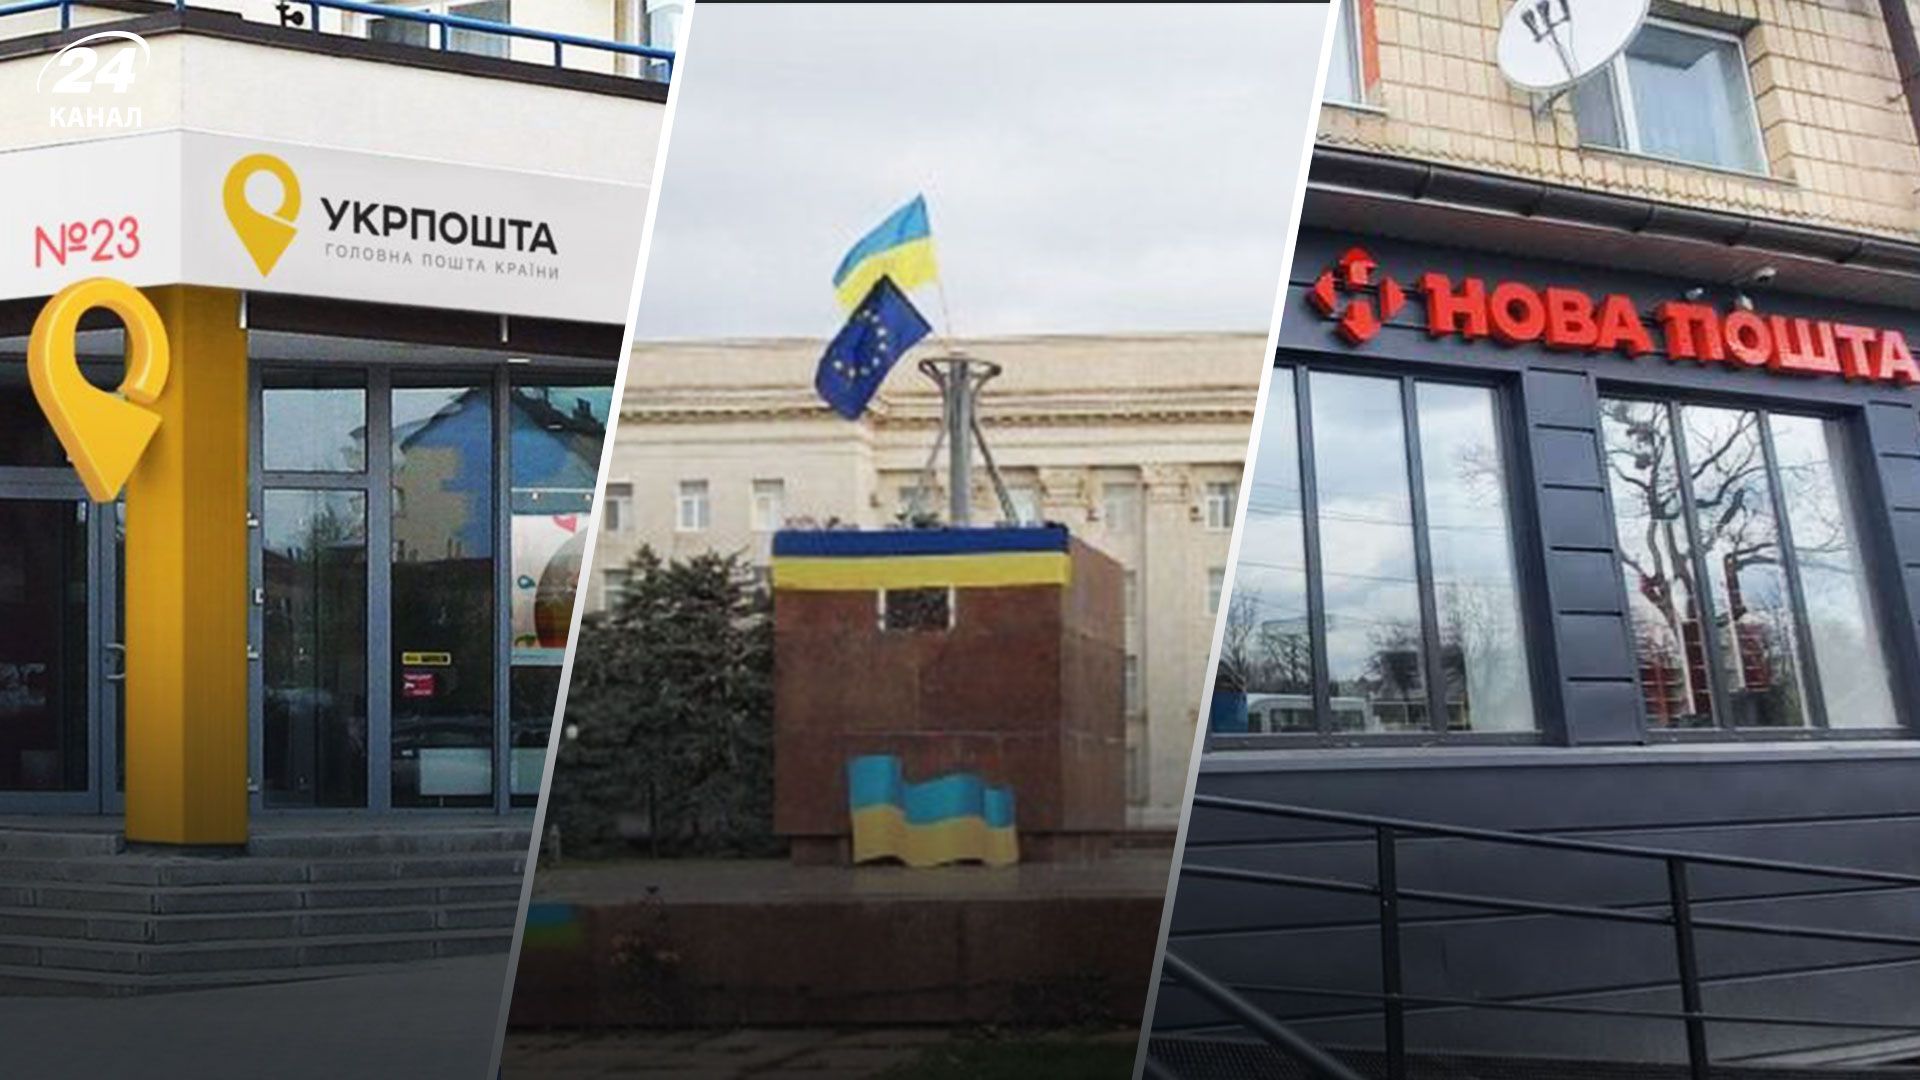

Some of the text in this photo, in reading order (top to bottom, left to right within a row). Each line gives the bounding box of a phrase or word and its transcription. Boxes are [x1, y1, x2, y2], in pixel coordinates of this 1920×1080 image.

[35, 215, 141, 268] №23
[320, 197, 558, 255] УКРПОШТА
[325, 243, 560, 281] ГОЛОВНА ПОШТА КРАЇНИ
[1422, 273, 1920, 385] НОВА ПОШТА
